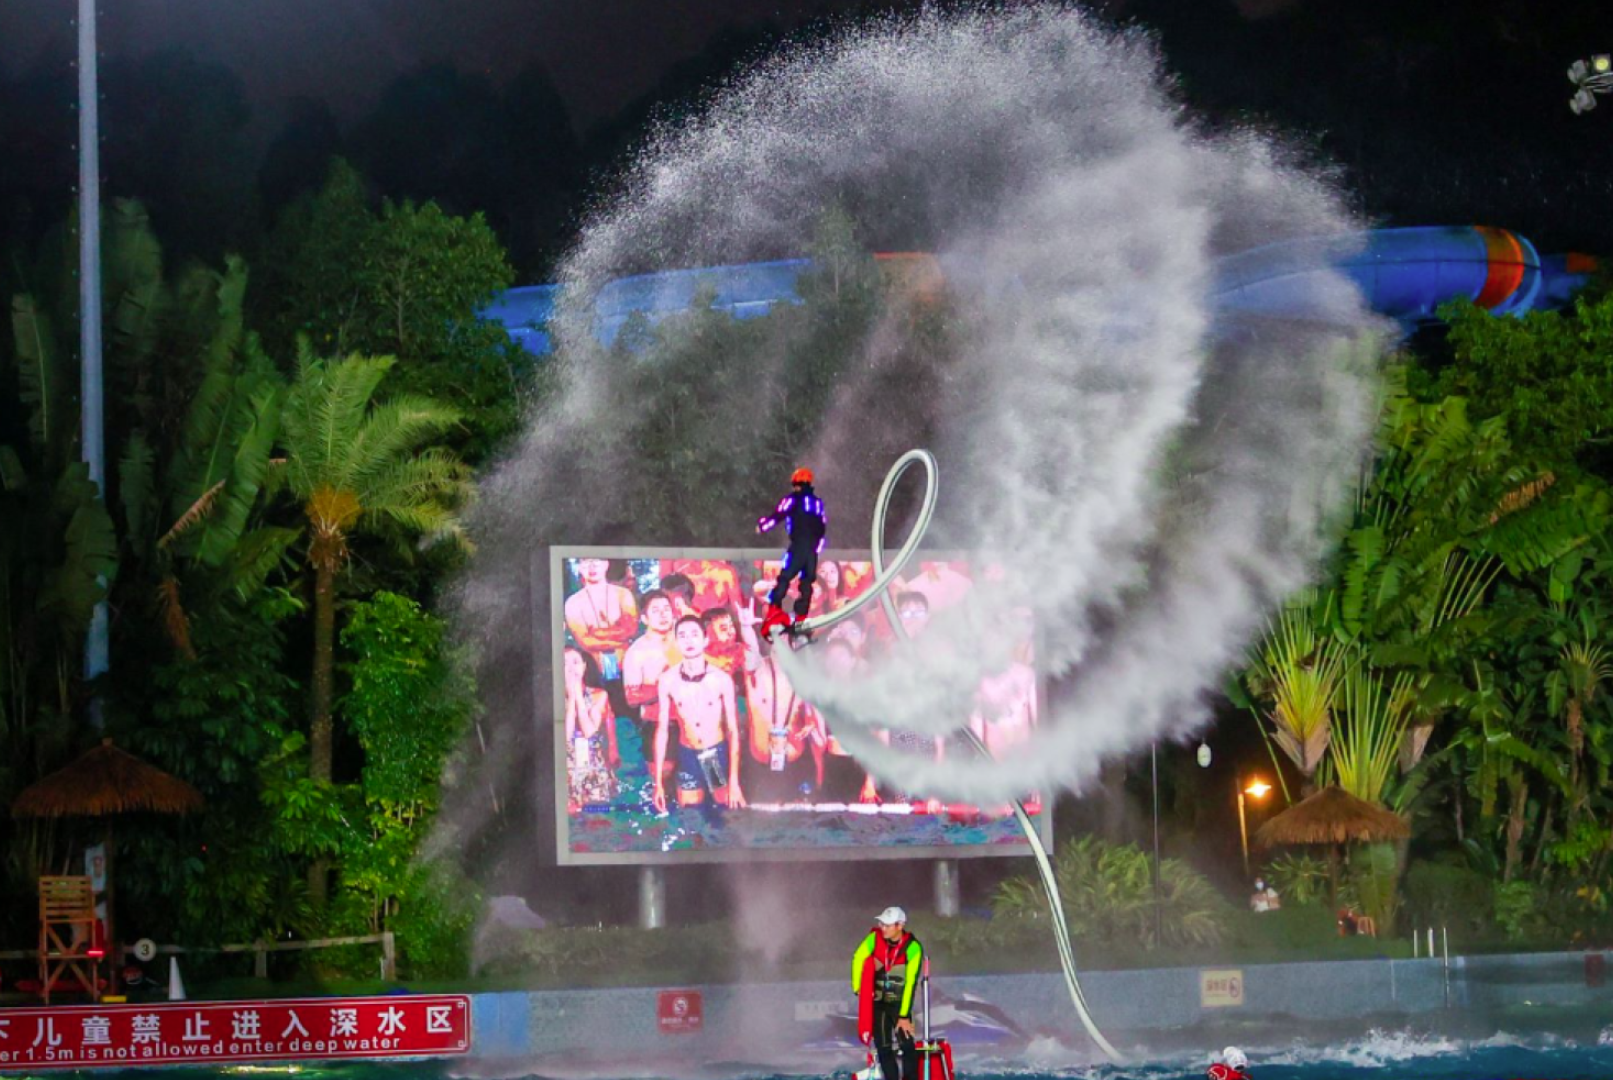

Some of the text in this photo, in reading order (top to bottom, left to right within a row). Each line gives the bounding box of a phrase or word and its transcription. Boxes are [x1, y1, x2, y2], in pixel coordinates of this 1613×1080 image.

[141, 944, 150, 956] 3
[26, 1046, 74, 1060] 1.5m
[80, 1046, 97, 1059] is
[103, 1043, 137, 1058] not
[142, 1040, 223, 1057] allowed
[229, 1039, 283, 1053] enter
[289, 1037, 338, 1054] deep
[344, 1035, 401, 1050] water
